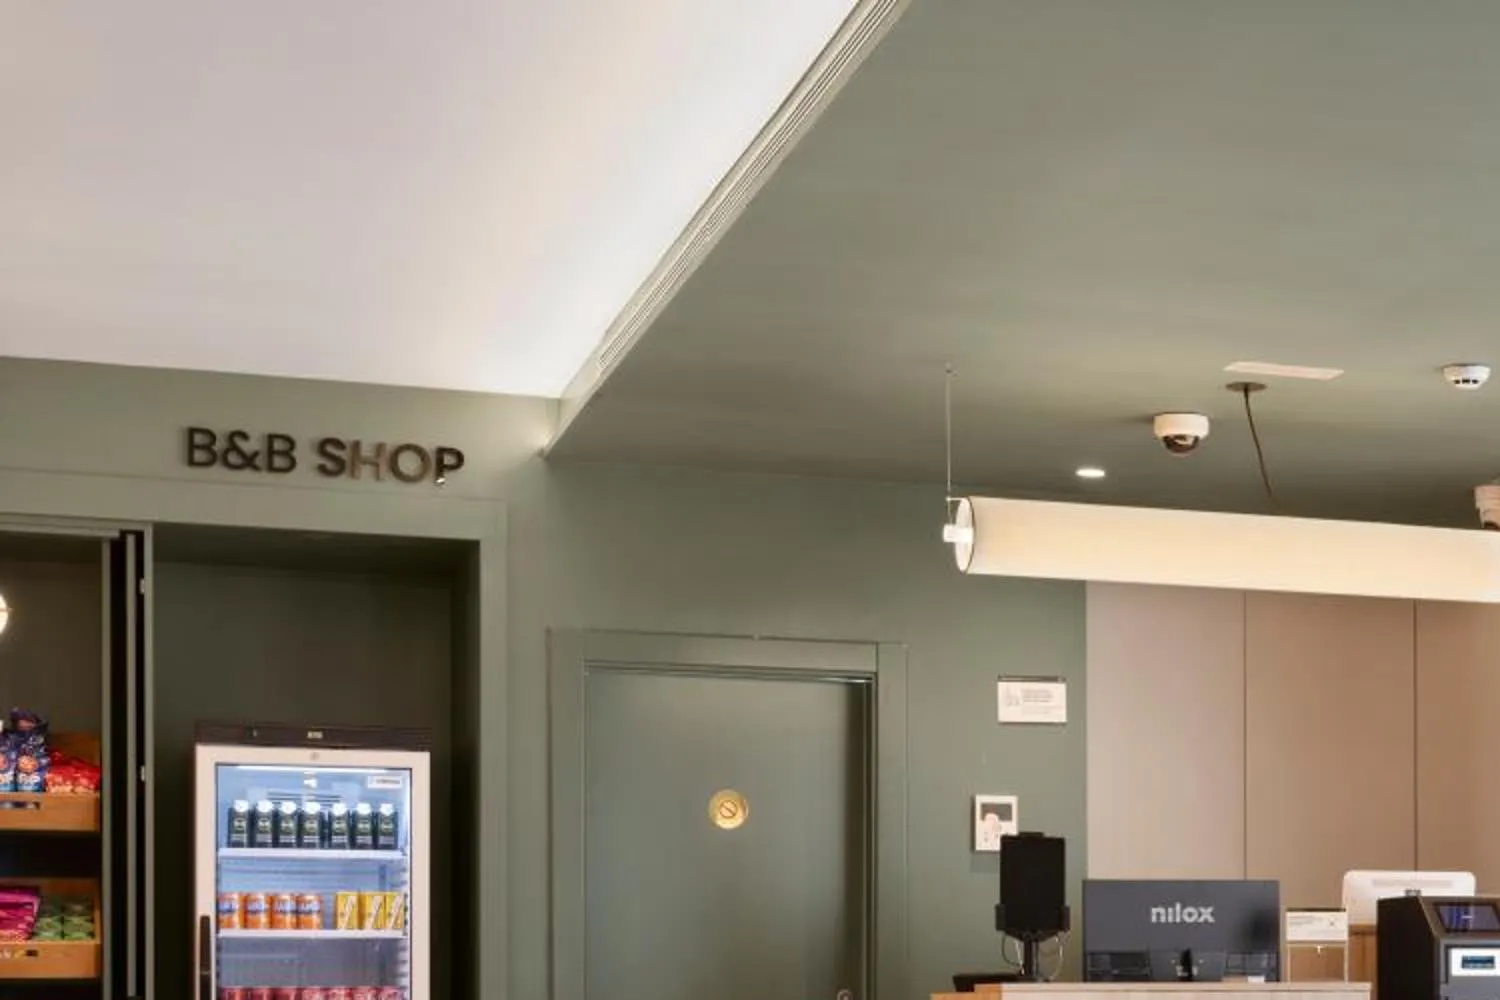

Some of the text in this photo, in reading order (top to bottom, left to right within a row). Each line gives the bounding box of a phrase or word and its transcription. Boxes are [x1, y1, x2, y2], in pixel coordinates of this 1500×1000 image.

[186, 426, 466, 485] B&B SHOP
[1151, 903, 1216, 924] nilox
